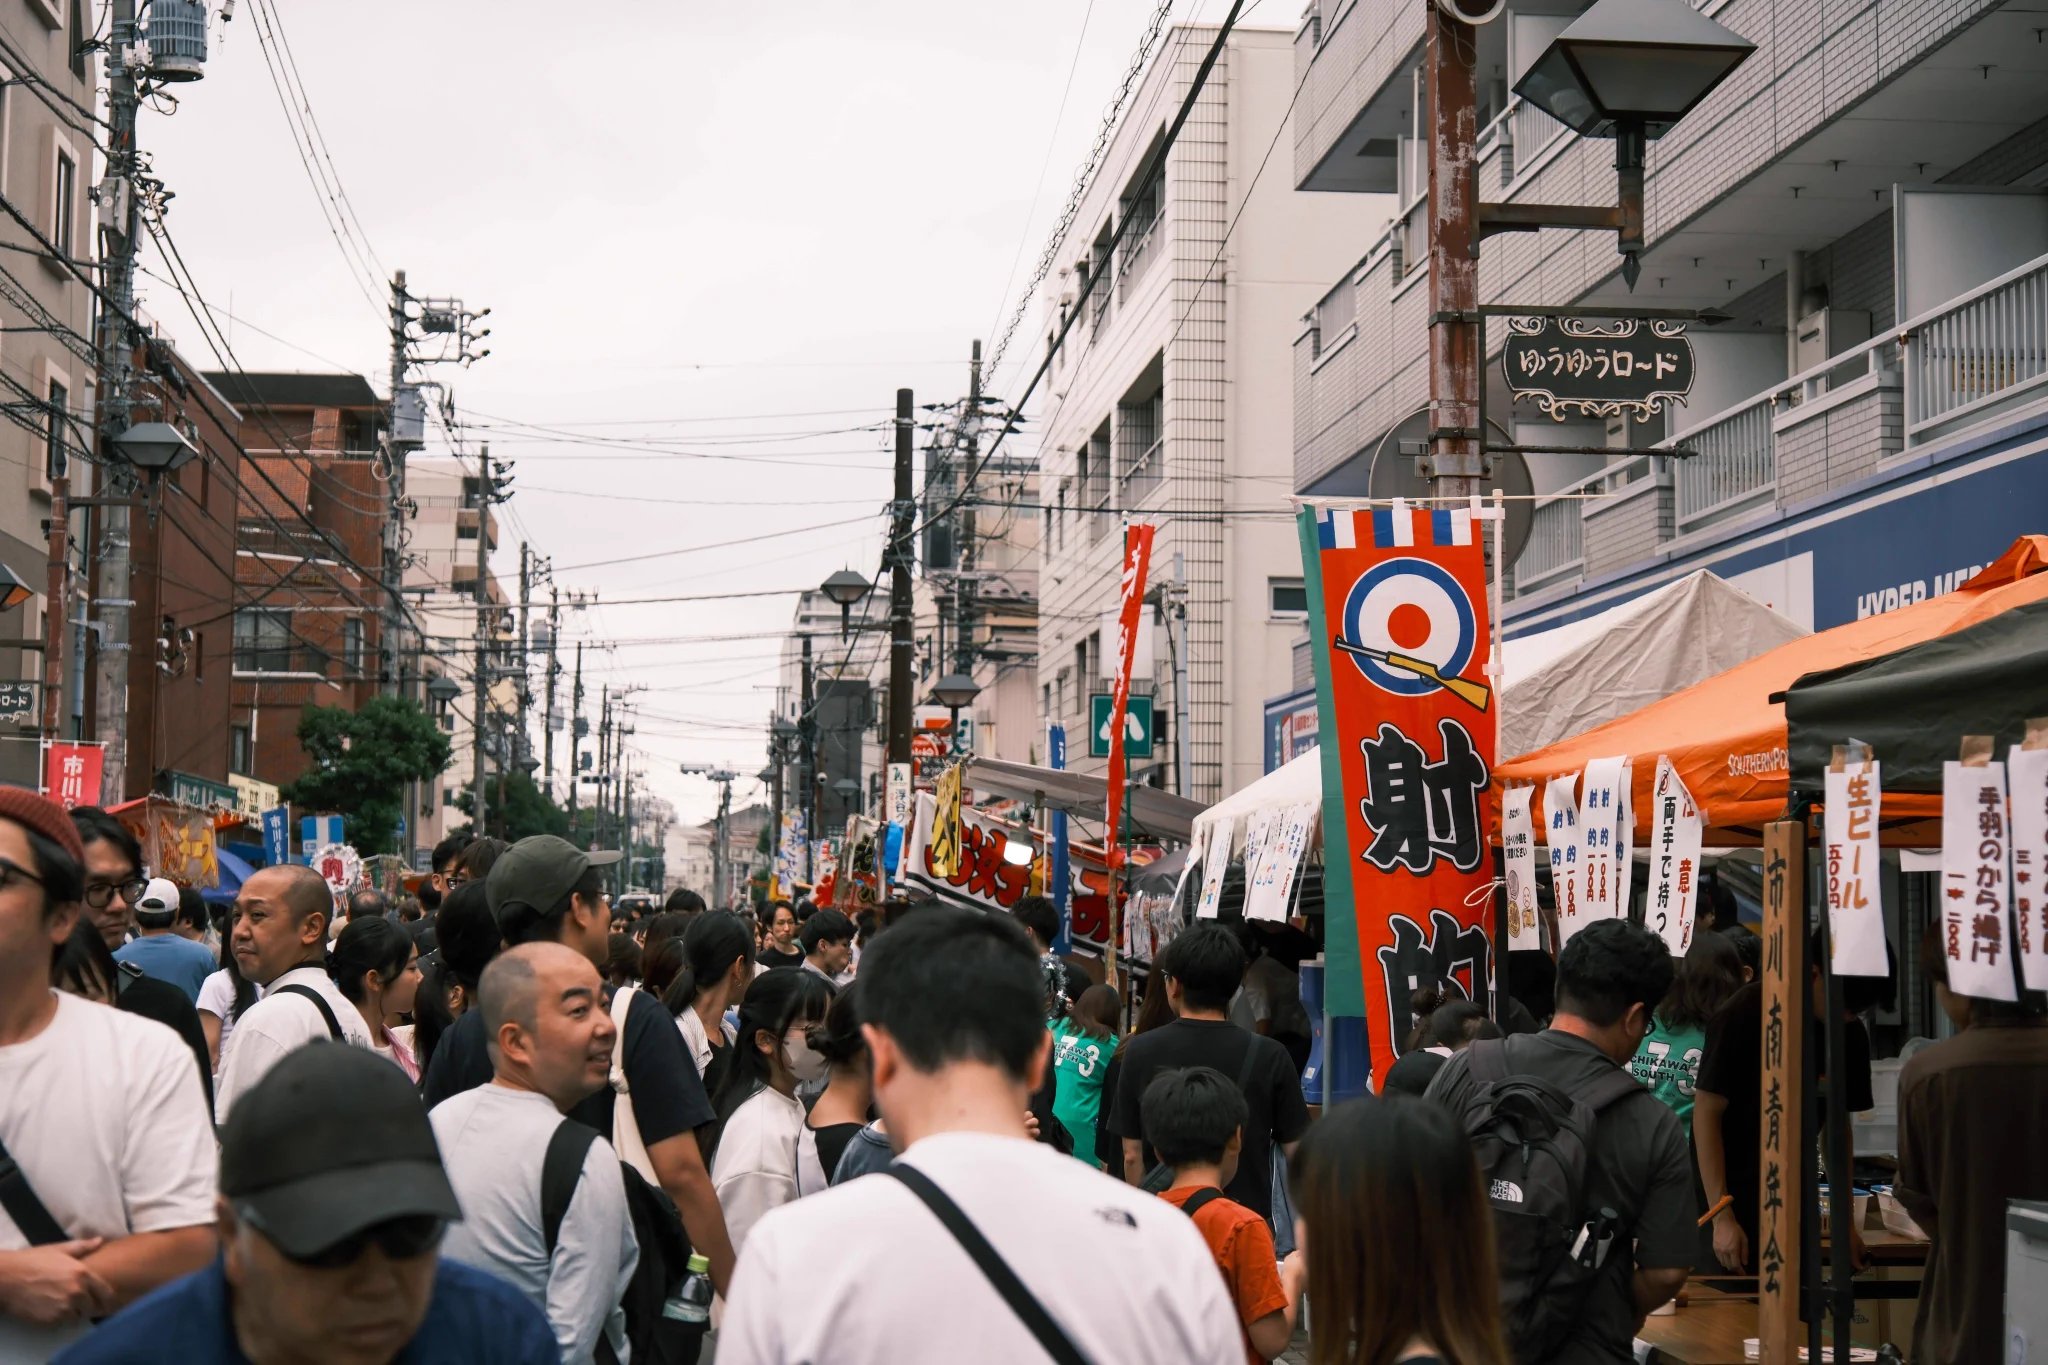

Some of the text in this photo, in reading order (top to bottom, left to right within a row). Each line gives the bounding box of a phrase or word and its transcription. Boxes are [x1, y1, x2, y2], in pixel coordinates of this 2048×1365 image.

[1519, 348, 1679, 380] ゆうゆうロード
[1843, 774, 1873, 909] 生ビール
[1656, 796, 1677, 933] 両手で持つ
[1633, 1067, 1675, 1082] SOUTH
[1493, 1179, 1509, 1187] THE
